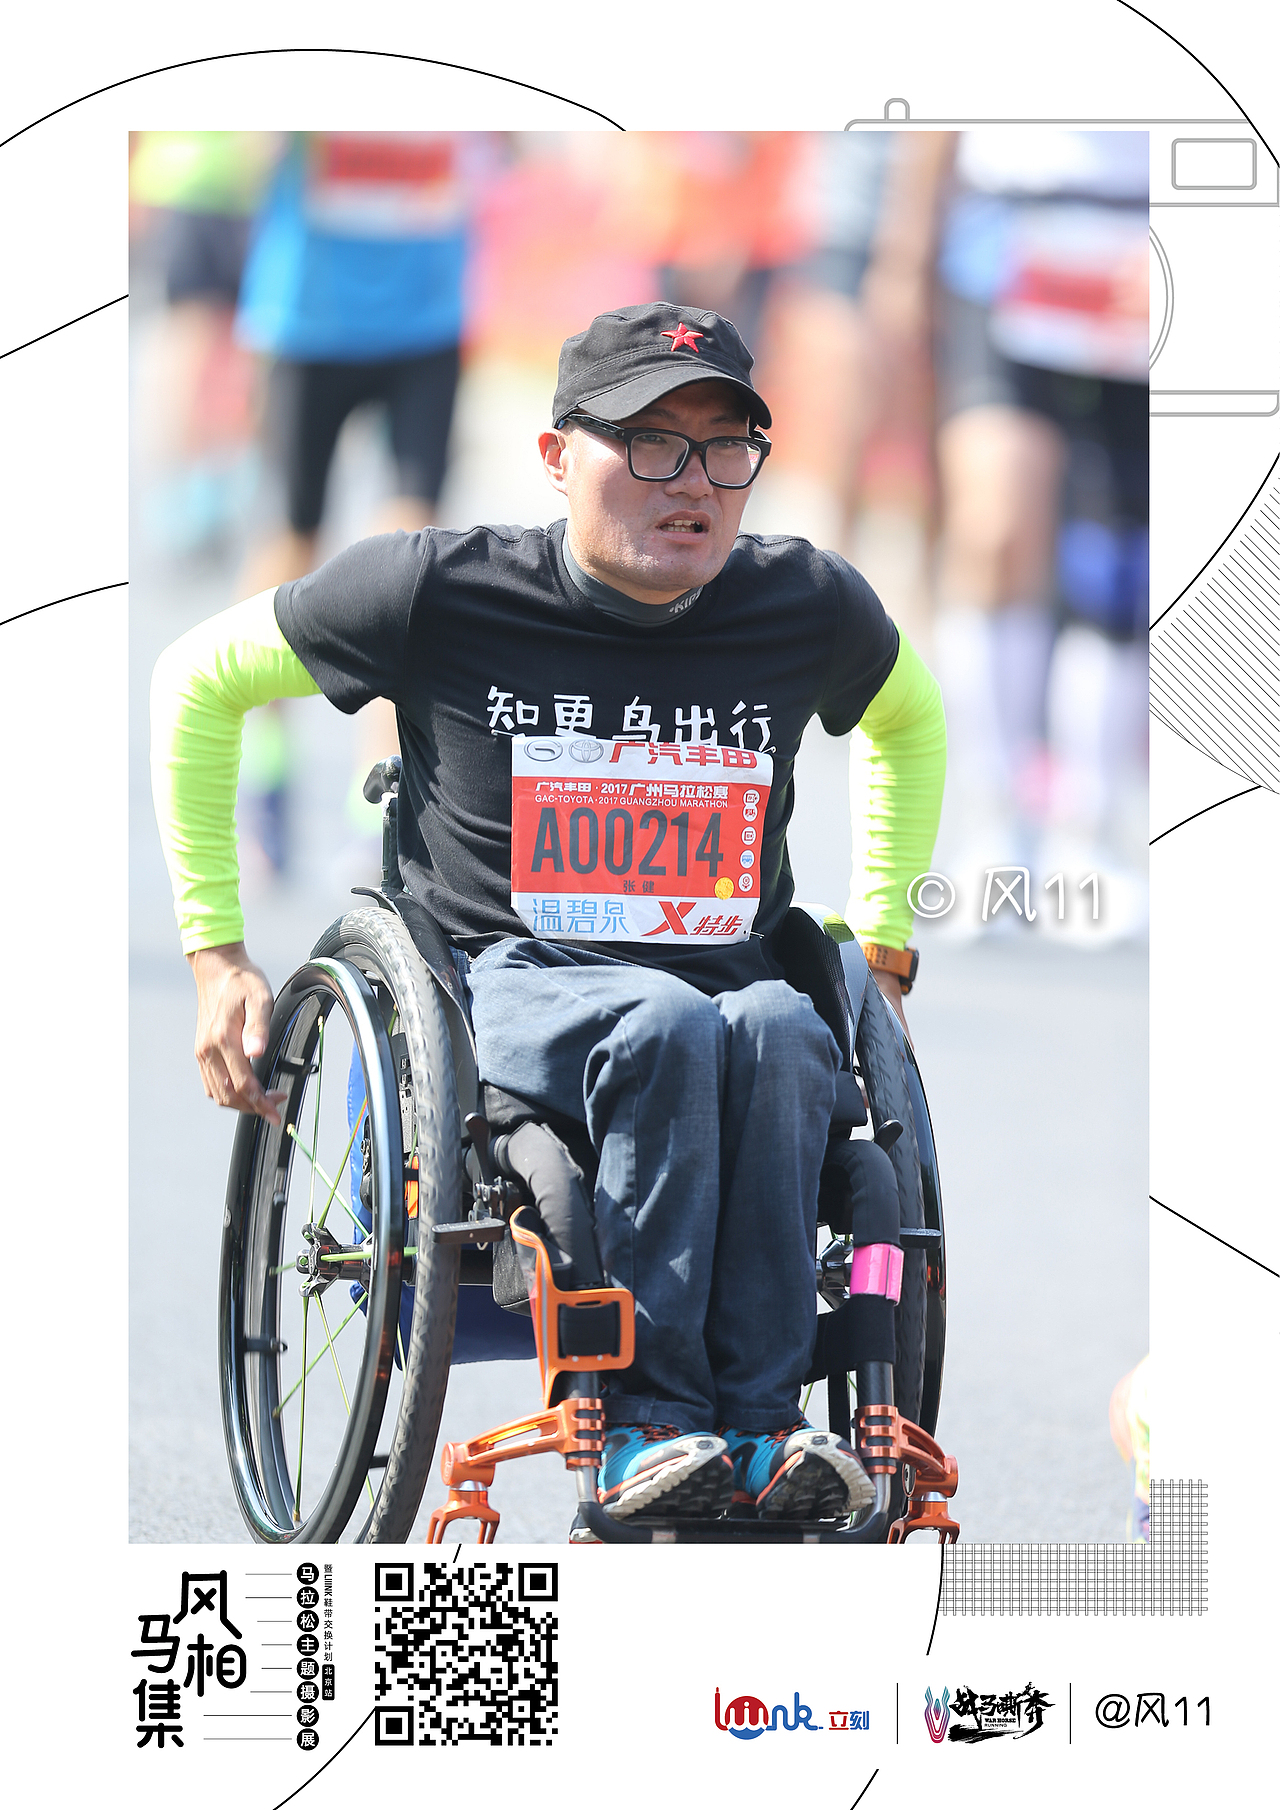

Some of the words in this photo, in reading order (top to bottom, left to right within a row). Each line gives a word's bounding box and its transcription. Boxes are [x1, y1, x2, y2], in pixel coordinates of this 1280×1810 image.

[609, 741, 757, 768] 广汽丰田
[619, 796, 678, 807] GUANGZHOU
[679, 798, 728, 808] MARATHON
[531, 807, 724, 878] A00214
[533, 899, 629, 934] 温碧泉
[689, 915, 744, 936] 特步
